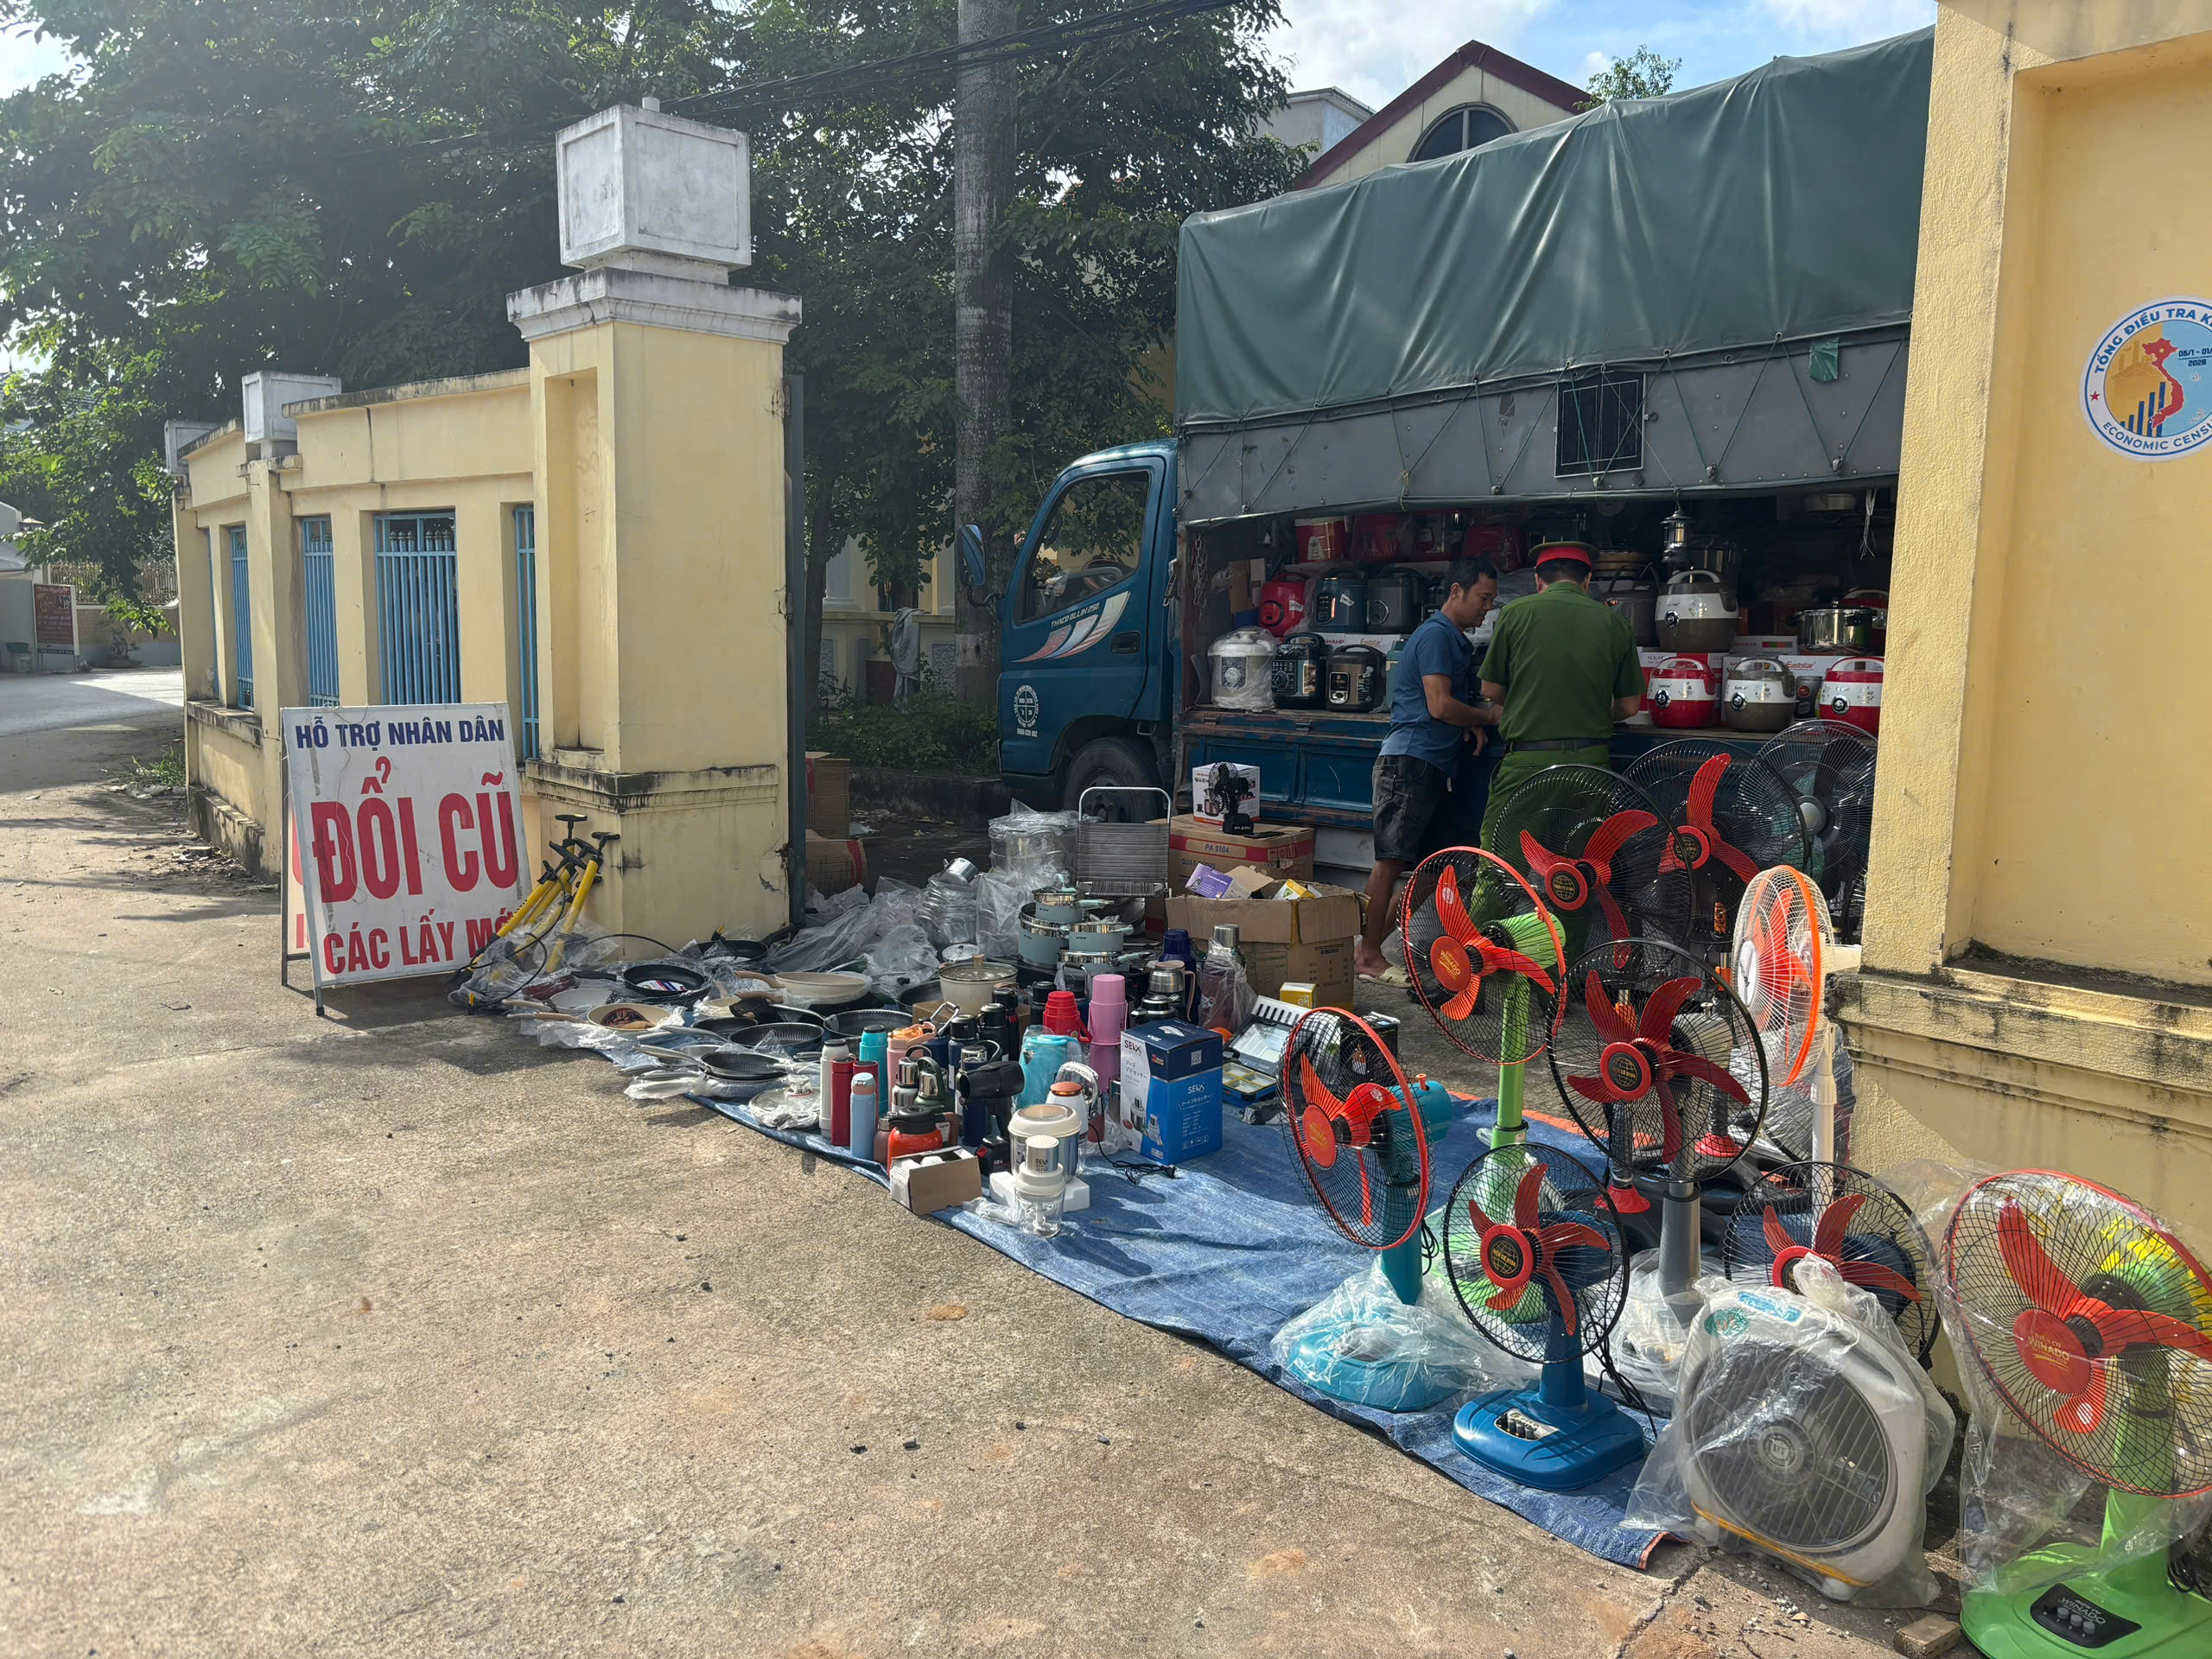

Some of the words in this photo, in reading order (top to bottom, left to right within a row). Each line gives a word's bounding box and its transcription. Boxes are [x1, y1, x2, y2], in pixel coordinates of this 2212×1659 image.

[2094, 335, 2123, 373] TỔNG
[2124, 311, 2160, 335] ĐIỀU
[2166, 308, 2196, 320] TRA
[2188, 359, 2207, 367] 2026
[2103, 422, 2168, 450] ECONOMIC
[2173, 419, 2212, 447] CENSU
[1051, 614, 1070, 628] THACO
[1069, 607, 1088, 621] OLLIN
[296, 716, 329, 749] HỖ
[335, 721, 381, 751] TRỢ
[388, 717, 454, 745] NHÂN
[459, 715, 505, 742] DÂN
[310, 755, 424, 904] ĐỔI
[438, 770, 519, 893] CŨ
[323, 921, 391, 975] CÁC
[399, 908, 455, 966] LẤY
[465, 907, 515, 958] MỚ
[2027, 1335, 2070, 1362] WINADO
[2057, 1597, 2107, 1625] WINADO
